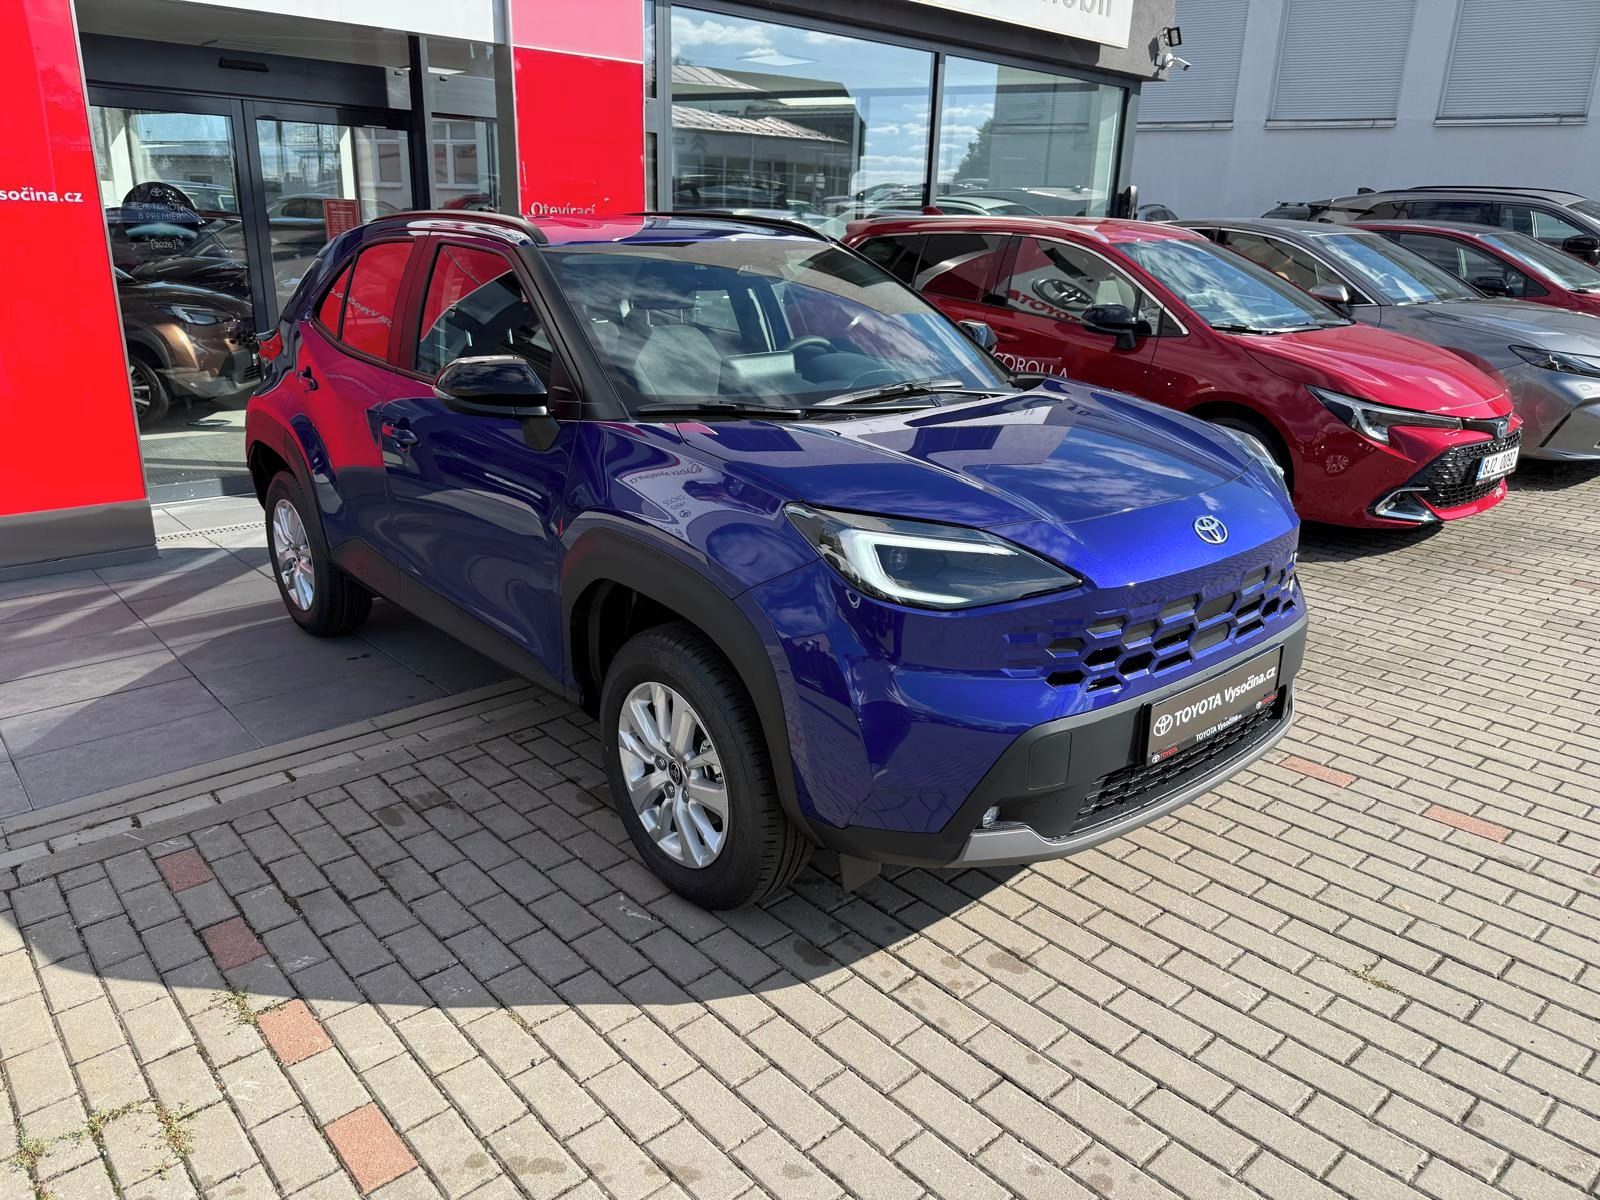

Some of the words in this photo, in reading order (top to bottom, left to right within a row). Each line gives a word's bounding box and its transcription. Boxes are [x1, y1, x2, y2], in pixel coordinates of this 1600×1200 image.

[0, 186, 83, 203] sočina.cz
[1174, 693, 1222, 727] TOYOTA
[1224, 666, 1276, 703] Vysočina.cz
[1195, 725, 1217, 742] TOYOTA
